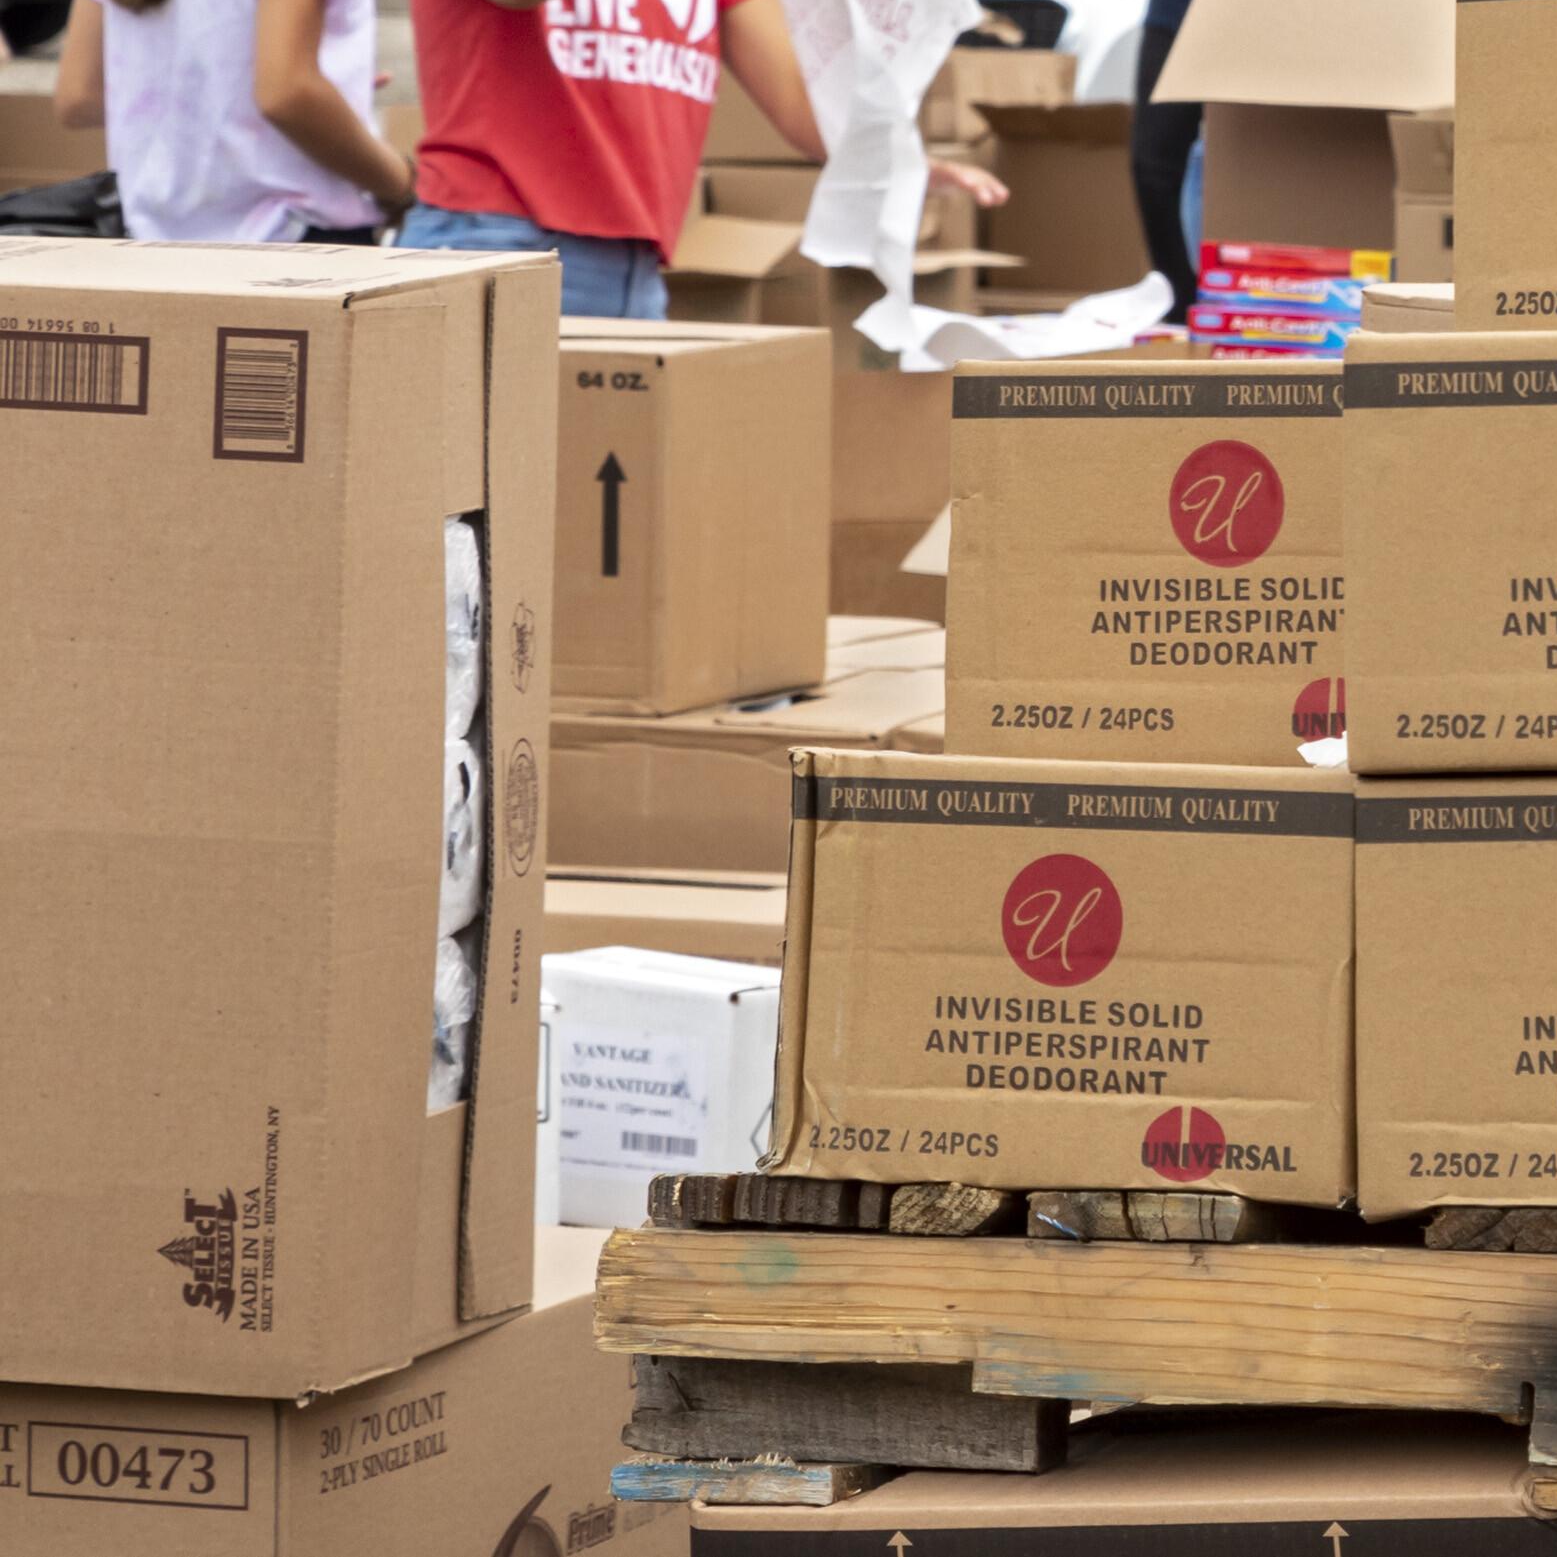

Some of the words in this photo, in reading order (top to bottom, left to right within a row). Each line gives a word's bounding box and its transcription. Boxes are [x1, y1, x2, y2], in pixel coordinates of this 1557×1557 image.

[578, 371, 604, 389] 64
[611, 373, 649, 391] OZ.
[1398, 369, 1503, 397] PREMIUM
[1101, 578, 1250, 602] INVISIBLE
[1090, 608, 1345, 635] ANTIPERSPIRAN
[1131, 641, 1318, 665] DEODORANT
[1397, 714, 1485, 739] 2.25OZ
[1495, 713, 1507, 738] /
[830, 787, 928, 811] PREMIUM
[937, 789, 1035, 814] QUALITY
[268, 1105, 280, 1126] NY
[264, 1130, 280, 1225] HUNTINGTON,
[1410, 1153, 1499, 1177] 2.25OZ
[1508, 1154, 1518, 1177] /
[243, 1187, 261, 1229] USA
[182, 1199, 217, 1309] SELECT
[243, 1238, 259, 1260] IN
[263, 1237, 275, 1281] TISSUE
[240, 1267, 258, 1331] MADE
[261, 1290, 274, 1332] SELECT
[320, 1428, 341, 1459] 30
[361, 1414, 381, 1446] 70
[386, 1392, 446, 1437] COUNT
[58, 1440, 215, 1495] 00473
[320, 1460, 357, 1494] 2-PLY
[363, 1443, 410, 1481] SINGLE
[414, 1431, 447, 1464] ROLL
